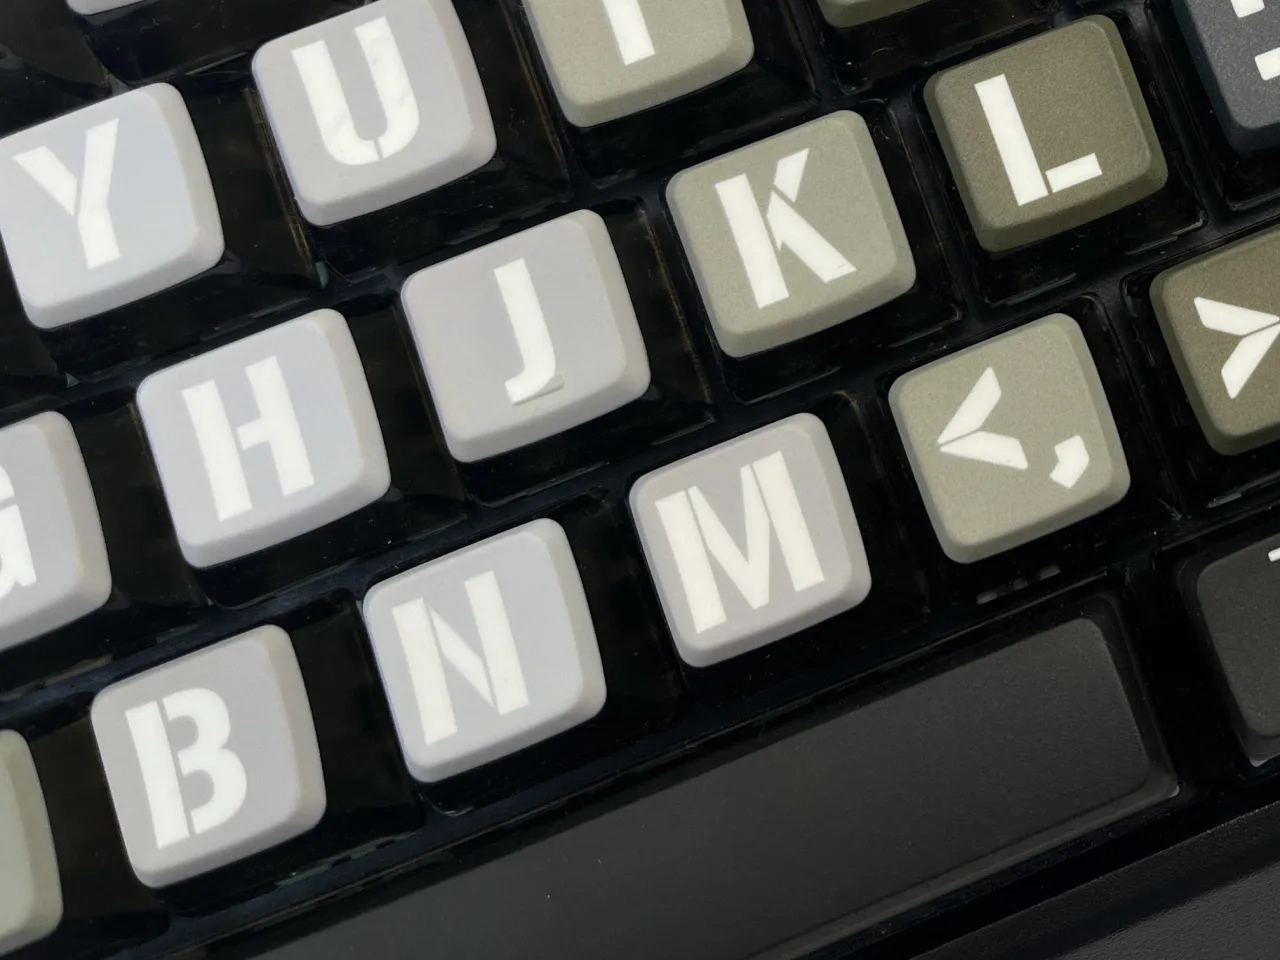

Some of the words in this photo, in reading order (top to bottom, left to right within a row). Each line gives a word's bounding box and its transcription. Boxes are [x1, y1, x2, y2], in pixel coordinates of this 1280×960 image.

[292, 17, 419, 165] U
[975, 74, 1102, 206] L
[13, 119, 120, 269] Y
[715, 149, 856, 308] K
[493, 258, 564, 405] J
[183, 357, 313, 520] H
[656, 452, 823, 632] M
[394, 572, 527, 743] N
[127, 690, 245, 847] B
